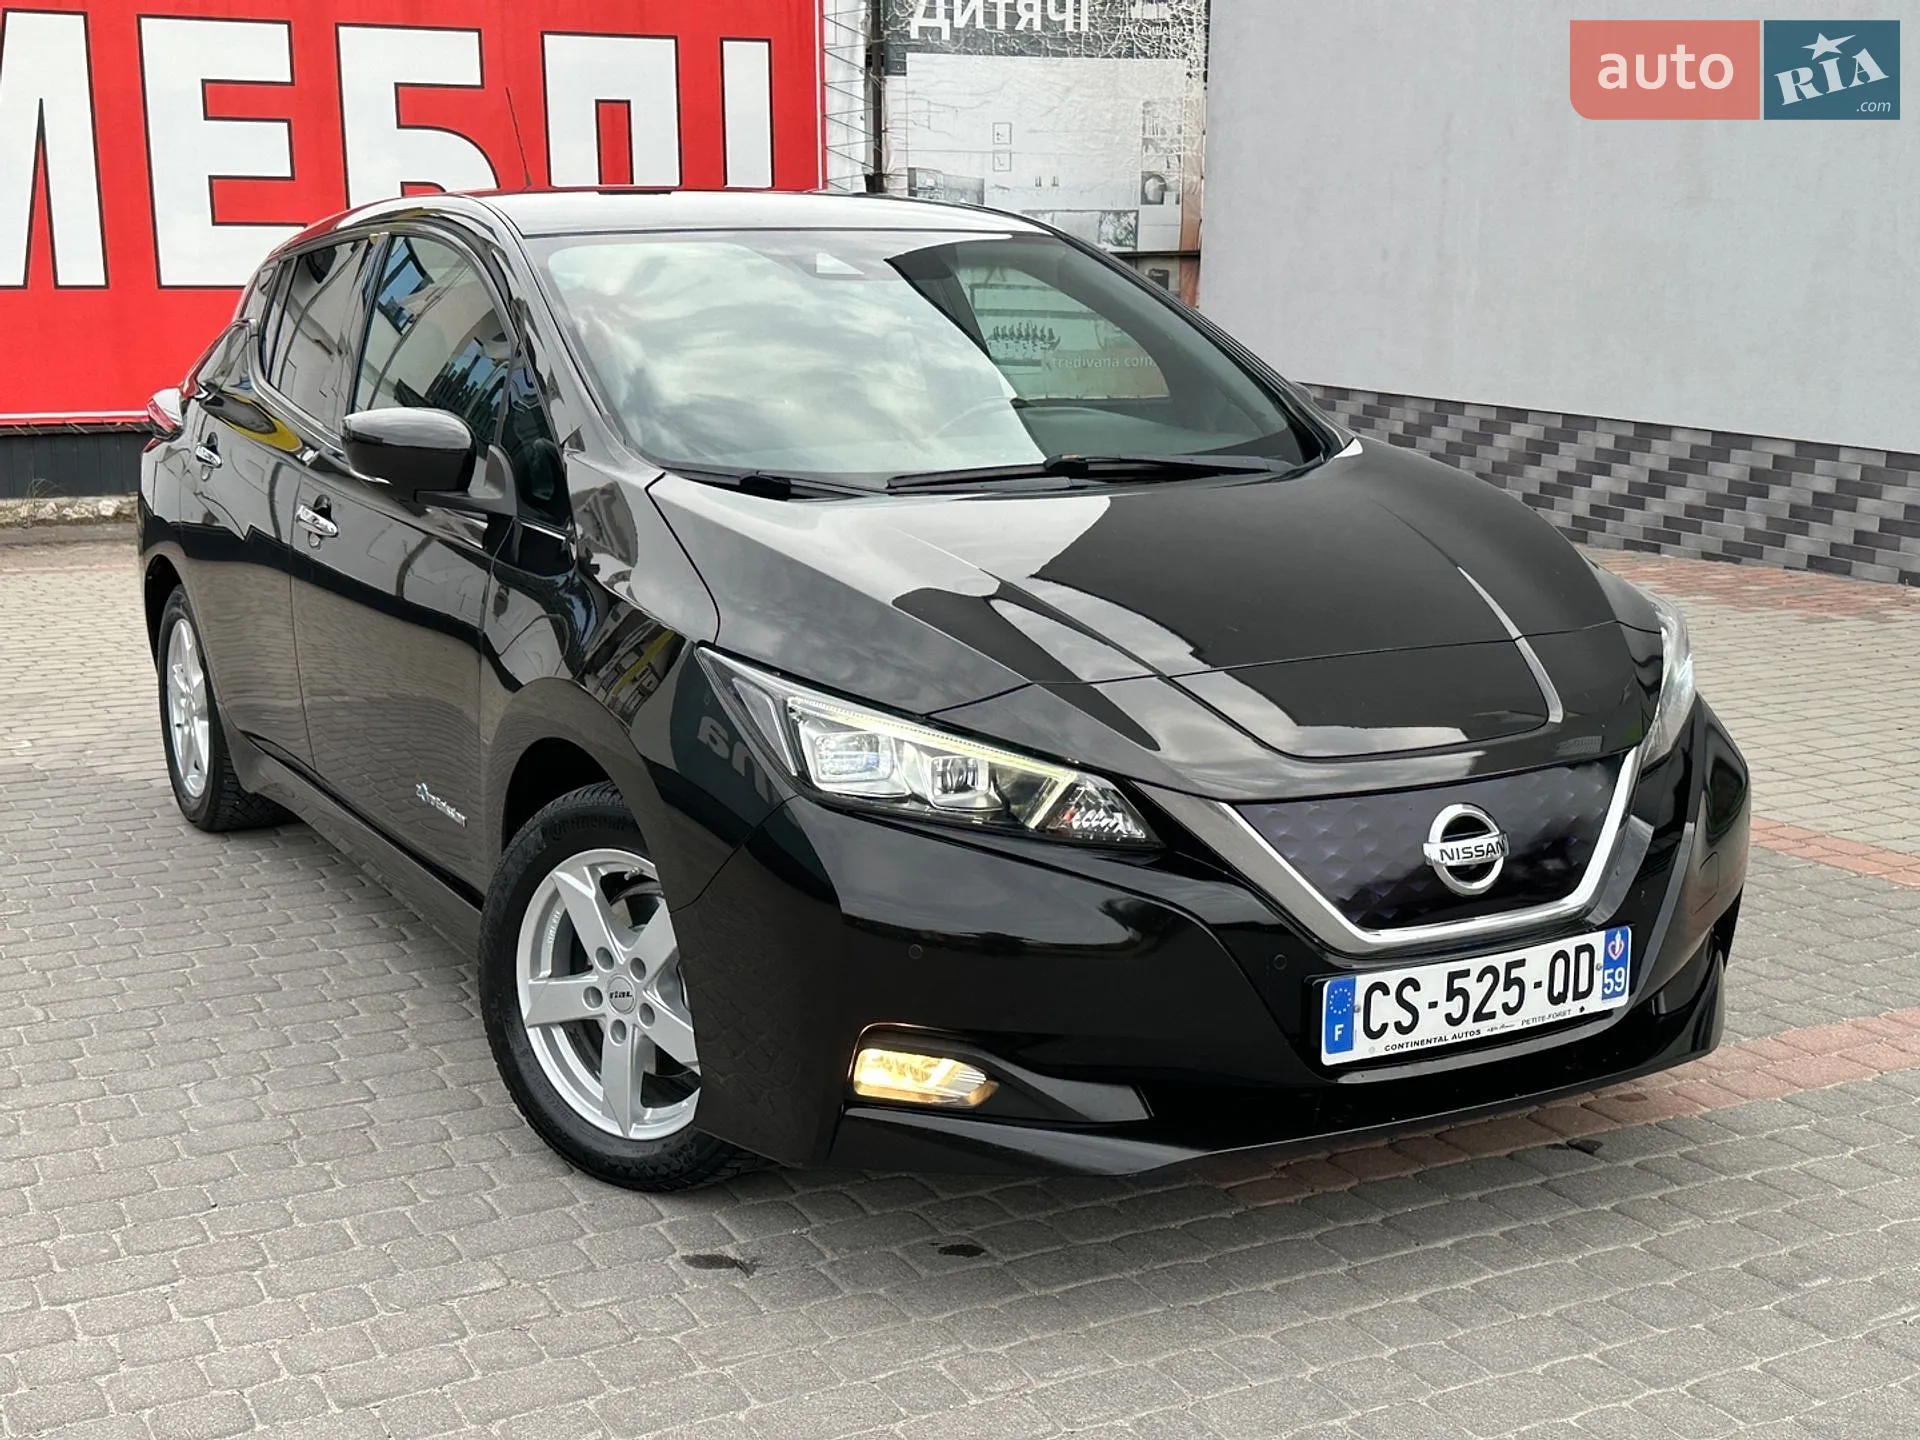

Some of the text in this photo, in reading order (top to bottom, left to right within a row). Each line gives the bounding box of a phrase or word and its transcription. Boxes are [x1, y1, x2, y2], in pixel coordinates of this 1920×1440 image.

[910, 0, 1090, 41] ДИТЯЧІ
[1439, 840, 1506, 862] NISSAN
[1362, 942, 1596, 1041] CS-525-QD
[1602, 966, 1627, 995] 59
[1334, 1023, 1345, 1042] F
[1384, 1029, 1482, 1052] CONTINENTAL AUTOS
